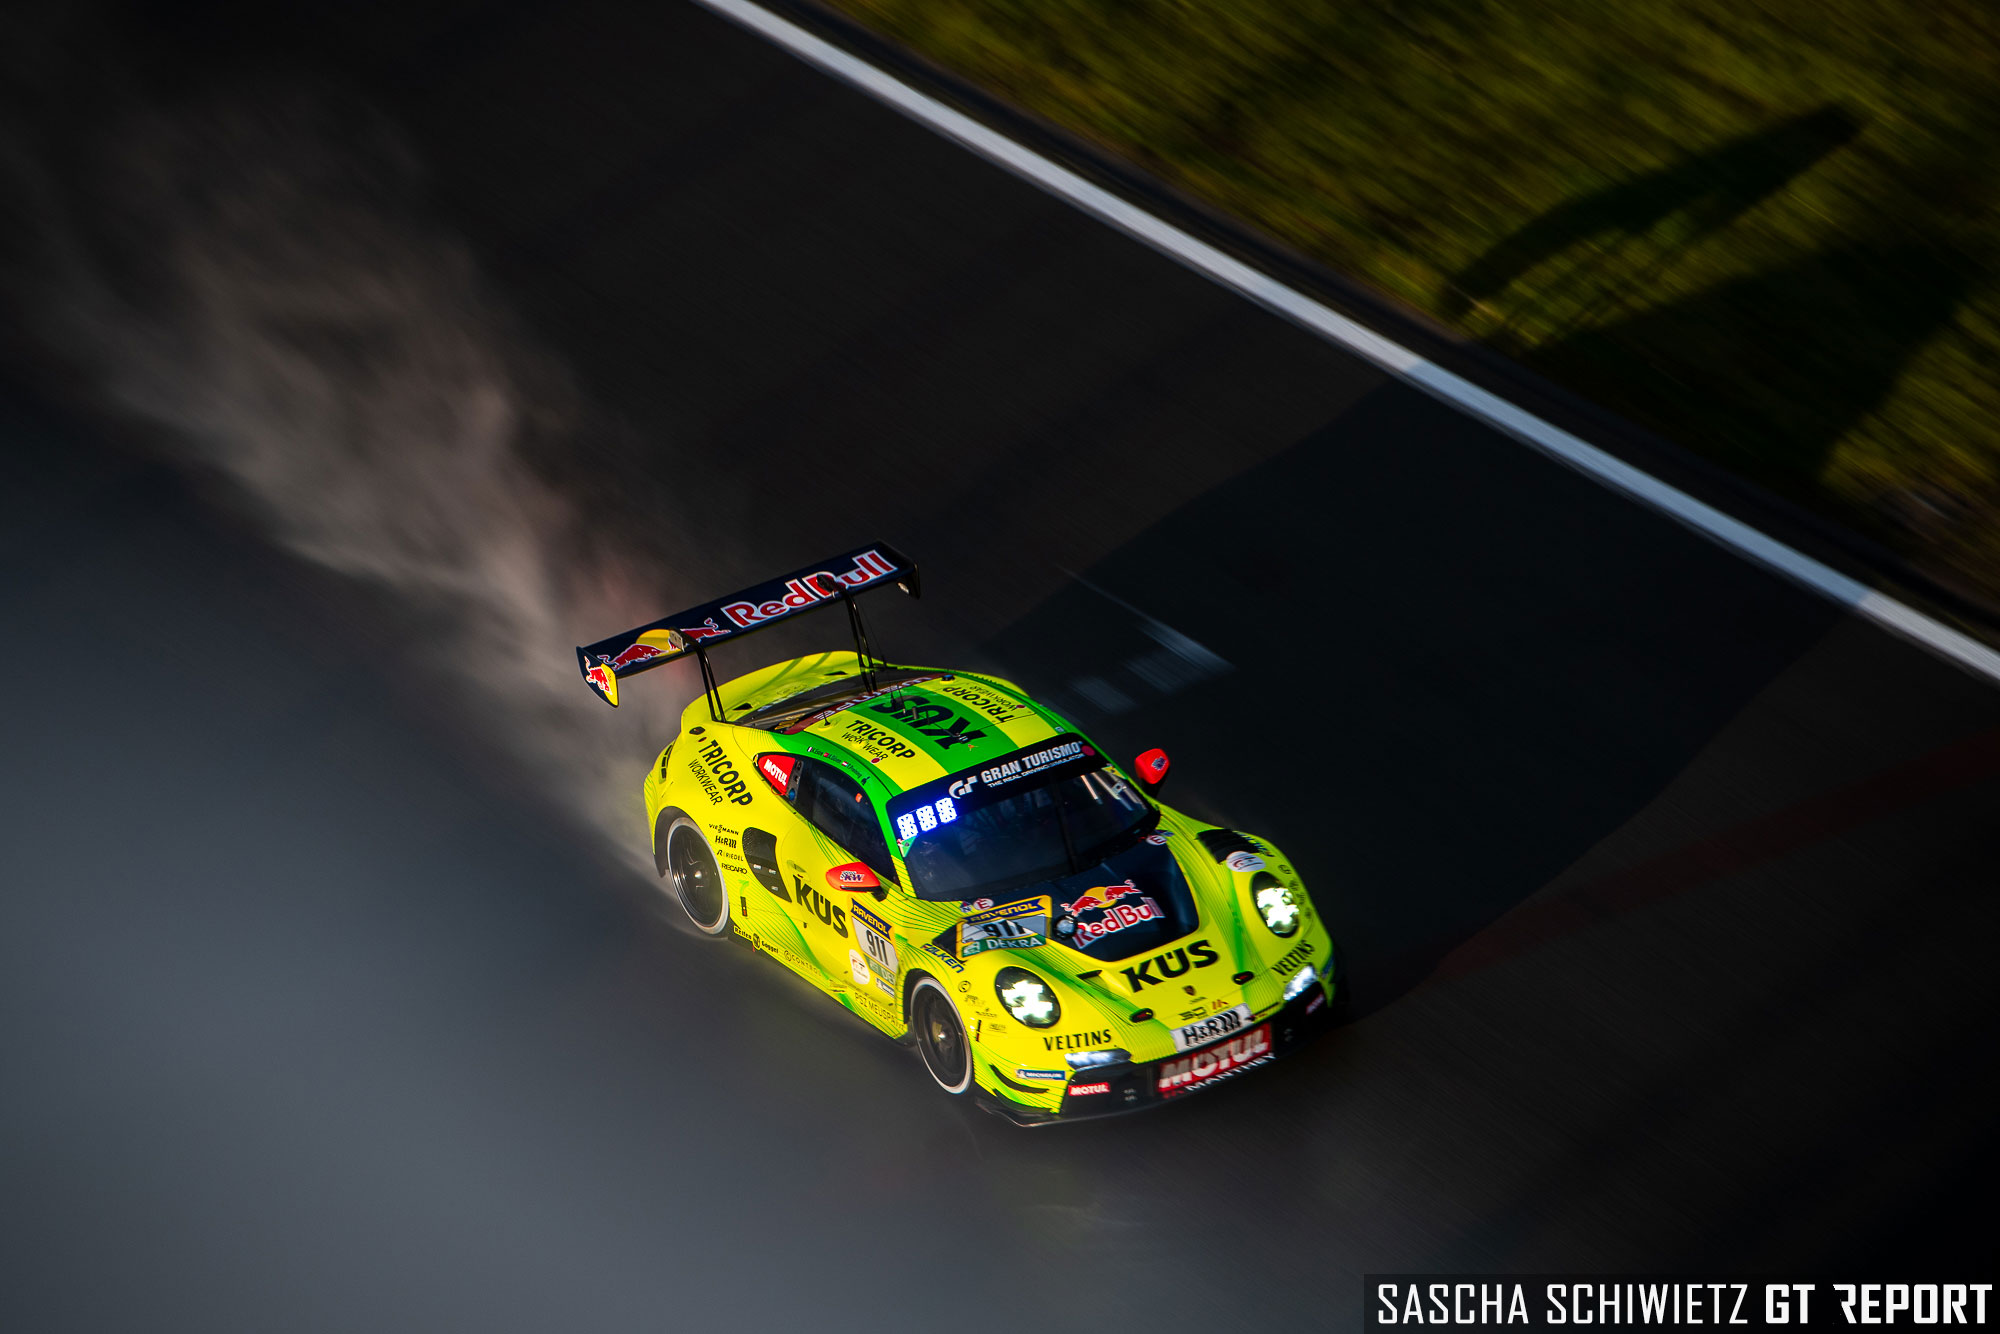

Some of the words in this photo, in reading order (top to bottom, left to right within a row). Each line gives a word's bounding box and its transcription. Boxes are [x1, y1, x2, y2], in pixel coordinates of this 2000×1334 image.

[943, 686, 1015, 723] TRICORP
[846, 719, 916, 759] TRICORP
[698, 739, 754, 806] TRICORP
[763, 758, 788, 787] MOTUL
[980, 759, 1023, 784] GRAN
[1021, 743, 1082, 770] TURISMO
[687, 758, 724, 806] WORKWEAR
[721, 862, 748, 875] RECARO
[725, 852, 744, 862] RIEDEL
[793, 874, 850, 939] KÜS
[852, 904, 888, 935] RAVENOL
[970, 902, 1038, 922] RAVENOL
[982, 919, 1026, 938] 911
[985, 936, 1043, 950] DEKRA
[866, 929, 889, 967] 911
[921, 943, 965, 973] FALKEN
[1270, 939, 1315, 977] VELTINS
[1119, 939, 1219, 993] KÜS
[1043, 1028, 1112, 1051] VELTINS
[1159, 1028, 1270, 1089] MOTUL
[1070, 1083, 1108, 1096] MOTUL
